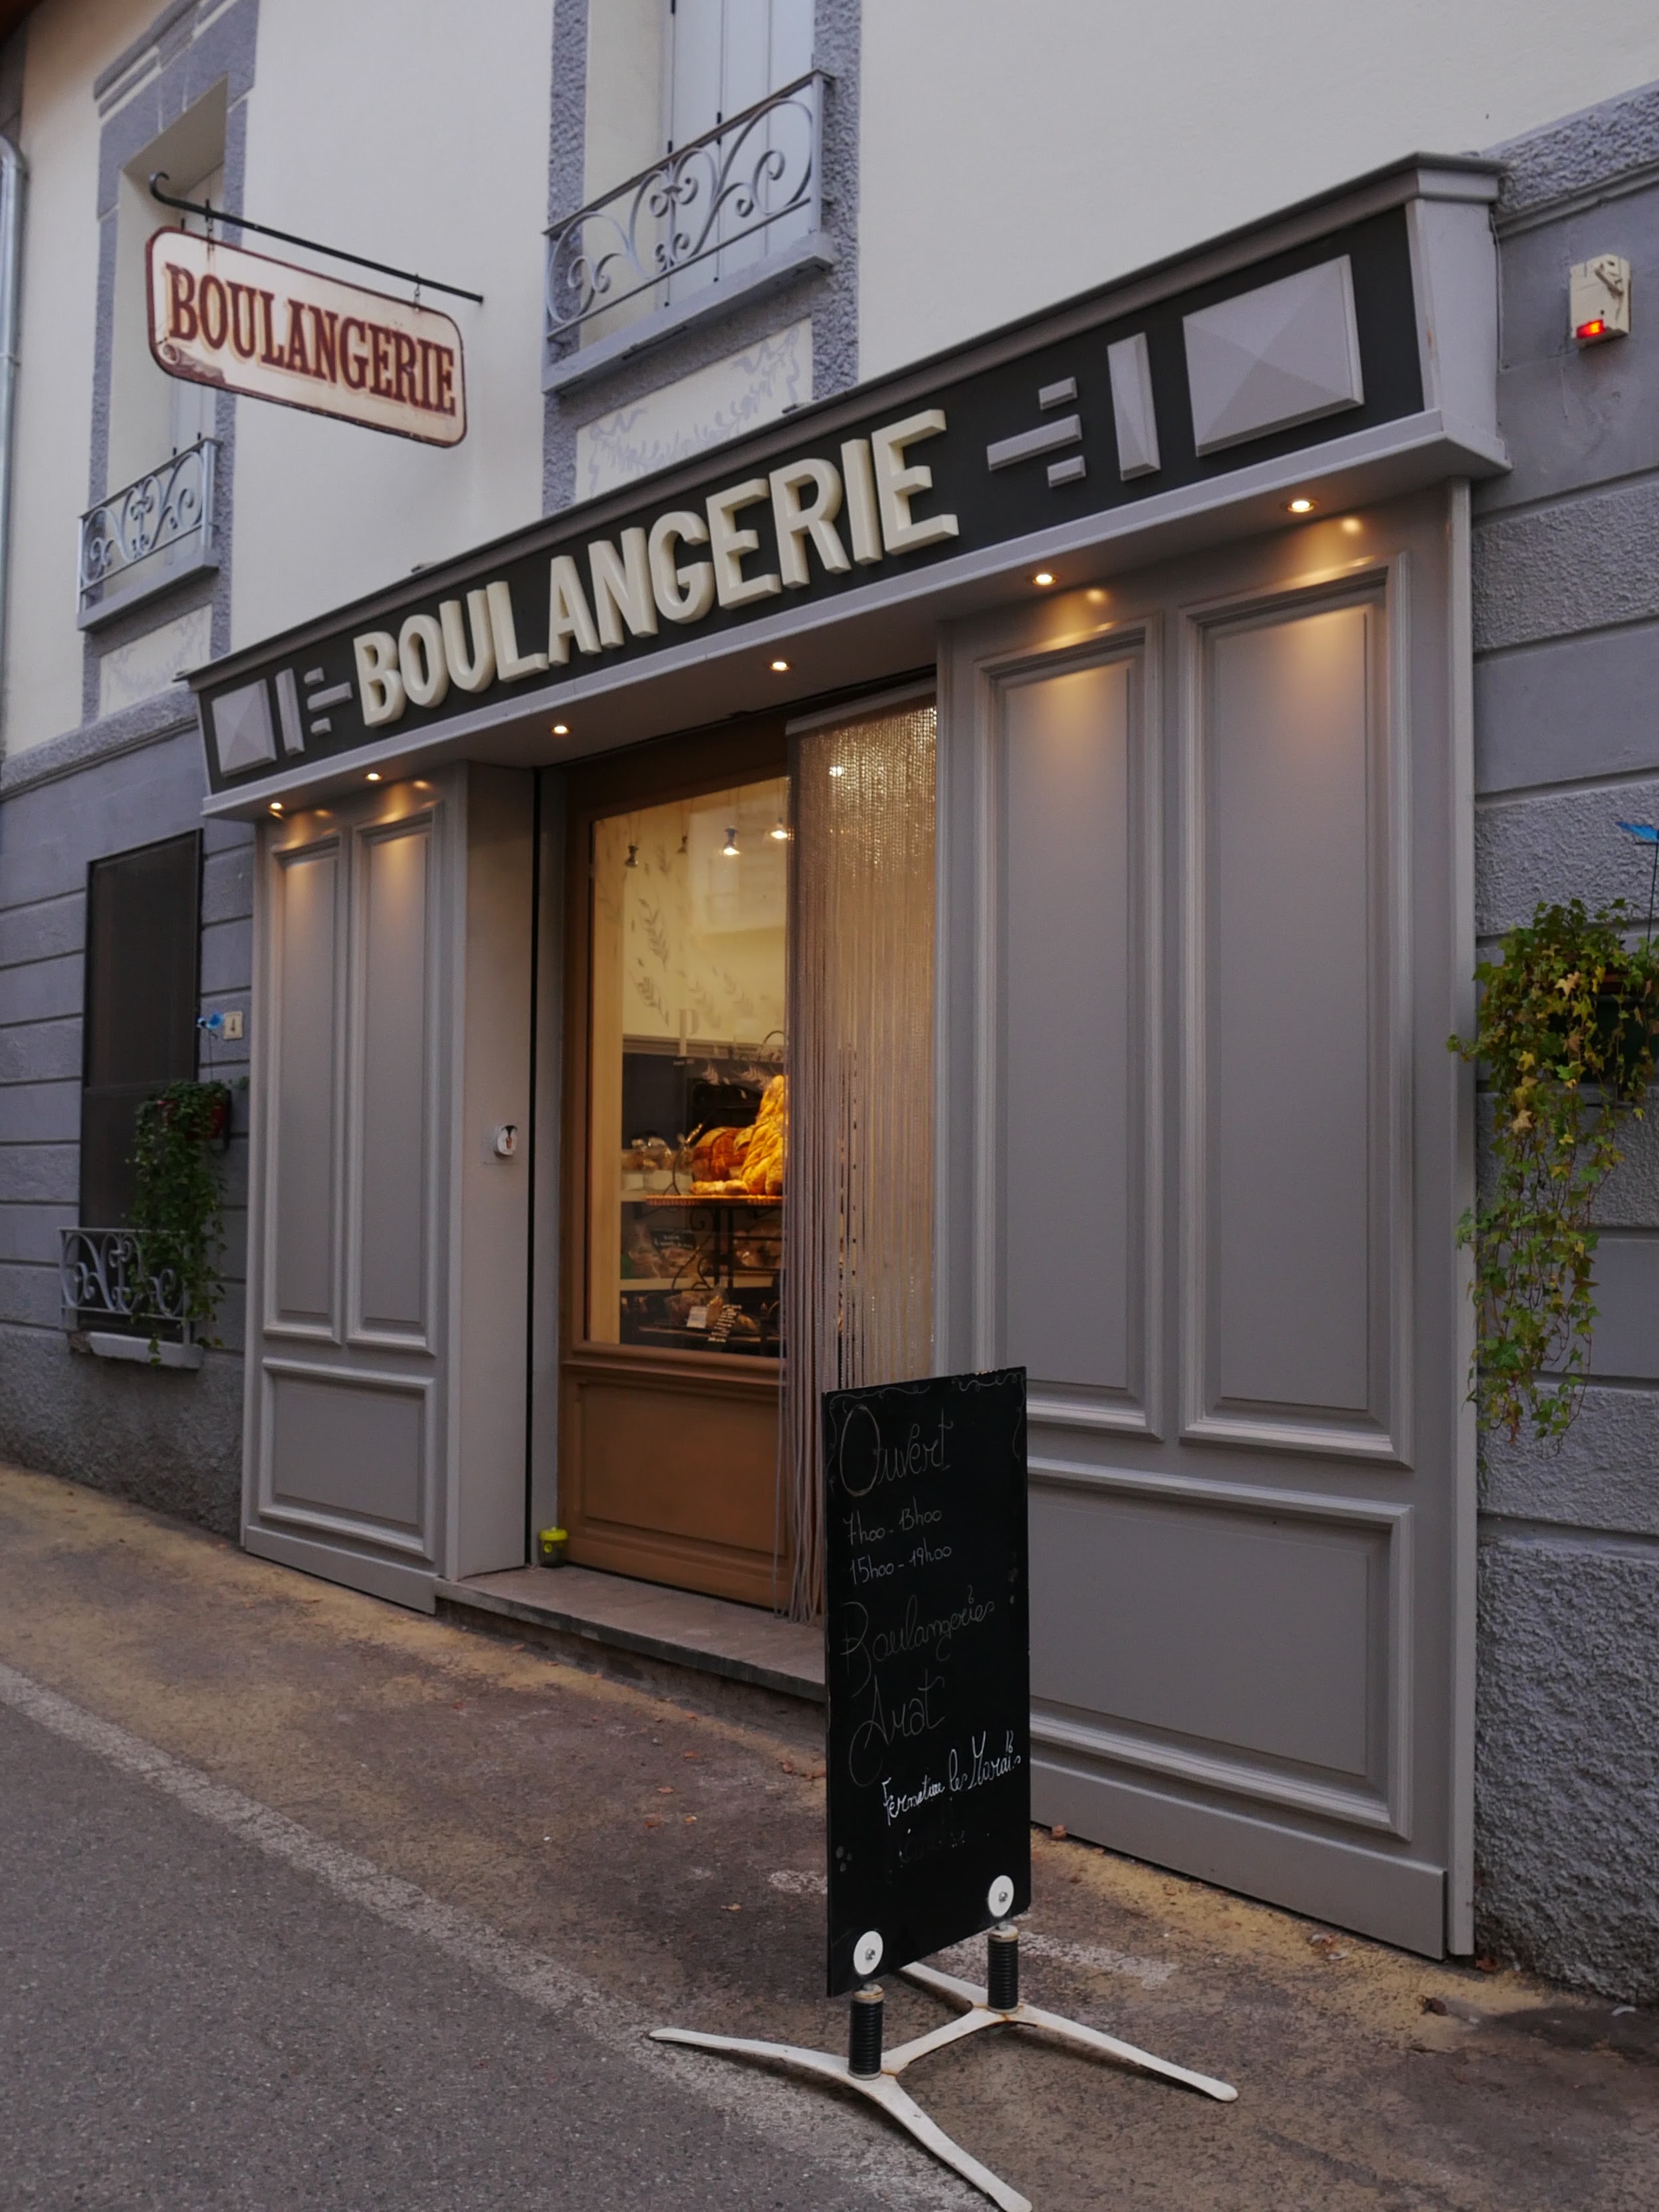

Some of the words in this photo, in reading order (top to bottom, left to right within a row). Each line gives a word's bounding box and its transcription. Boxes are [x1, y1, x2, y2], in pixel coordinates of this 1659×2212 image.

[164, 263, 456, 416] BOULANGERIE
[352, 408, 959, 728] BOULANGERIE
[839, 1402, 954, 1496] Ouvert
[843, 1507, 886, 1545] 7h00
[899, 1495, 942, 1531] 13h00
[849, 1554, 895, 1585] 15h00
[909, 1536, 952, 1567] 19h00
